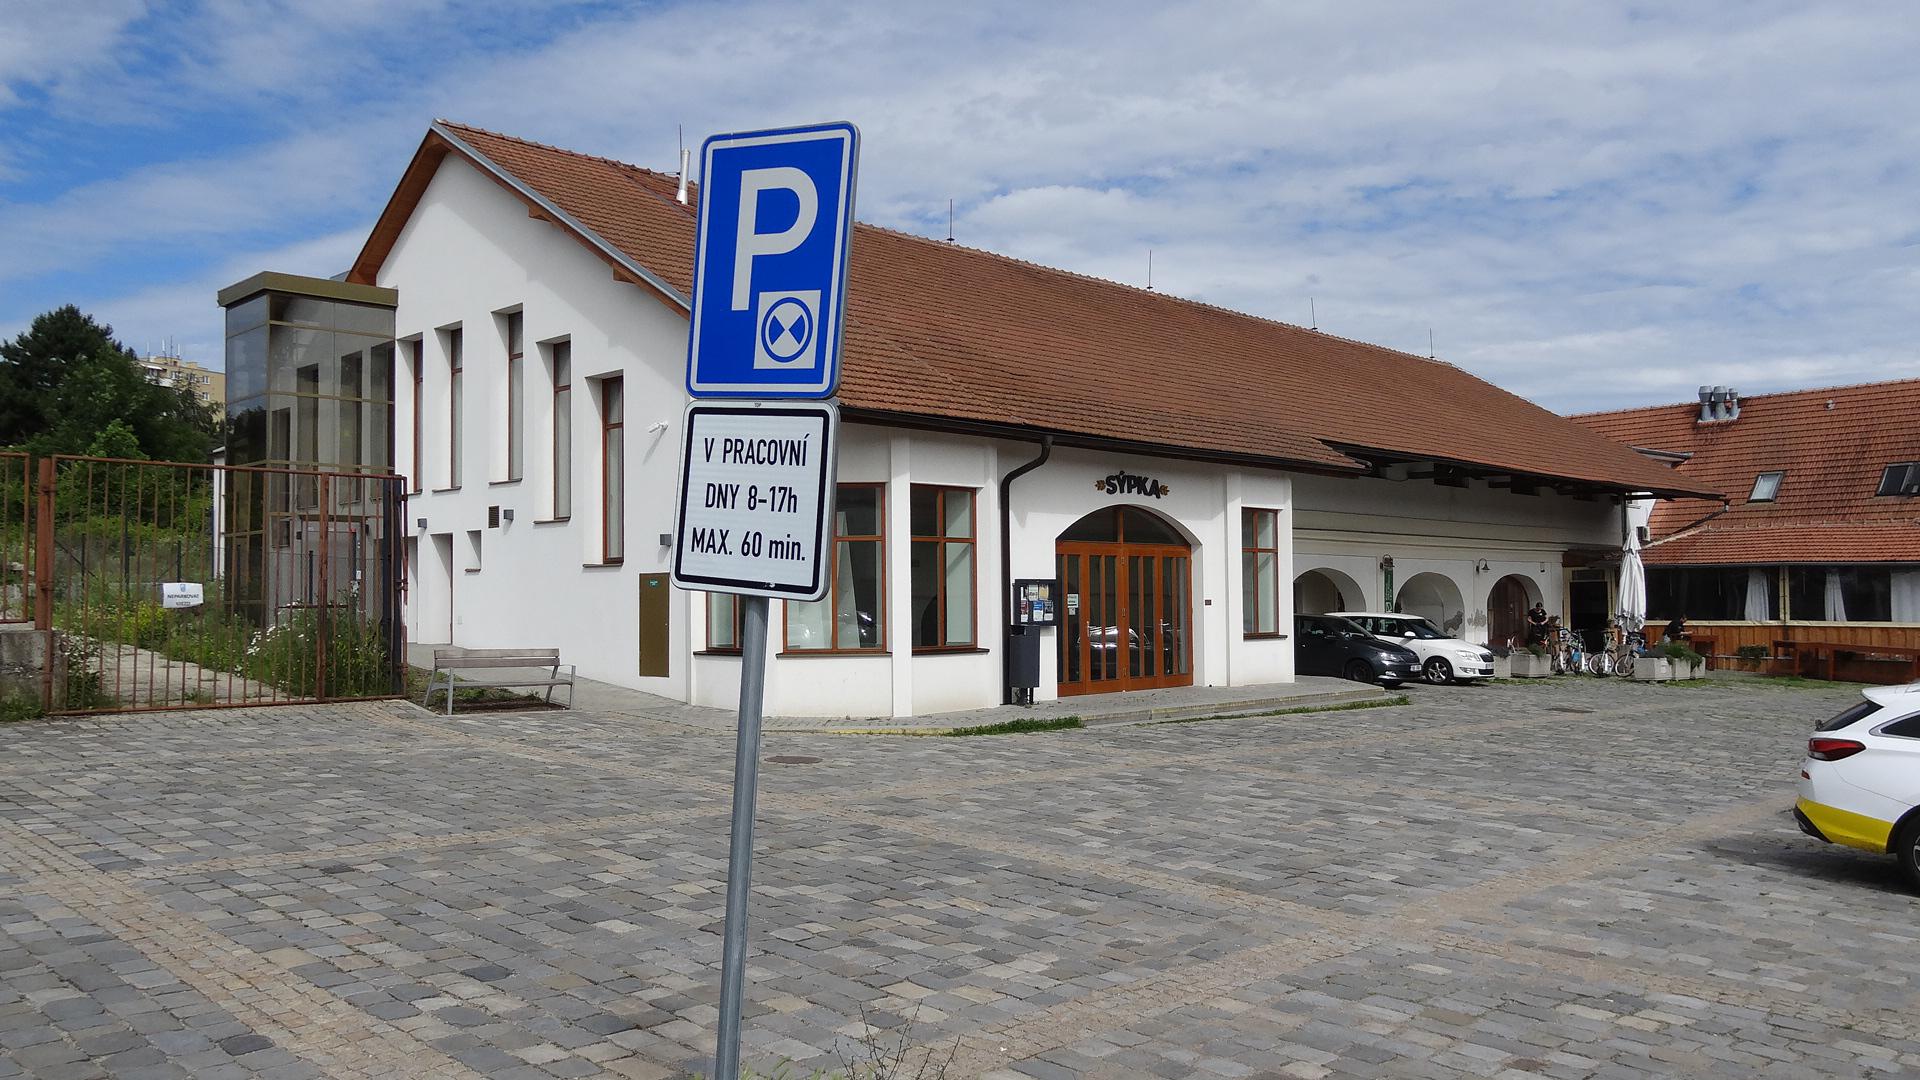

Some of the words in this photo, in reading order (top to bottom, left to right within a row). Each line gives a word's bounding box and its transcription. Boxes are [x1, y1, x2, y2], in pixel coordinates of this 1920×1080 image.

[731, 166, 819, 311] P
[704, 437, 715, 463] V
[722, 433, 810, 467] PRACOVNÍ
[705, 482, 740, 510] DNY
[747, 484, 798, 513] 8-17h
[1105, 470, 1161, 499] SÝPKA
[690, 526, 733, 556] MAX.
[741, 530, 763, 558] 60
[768, 533, 806, 561] min.
